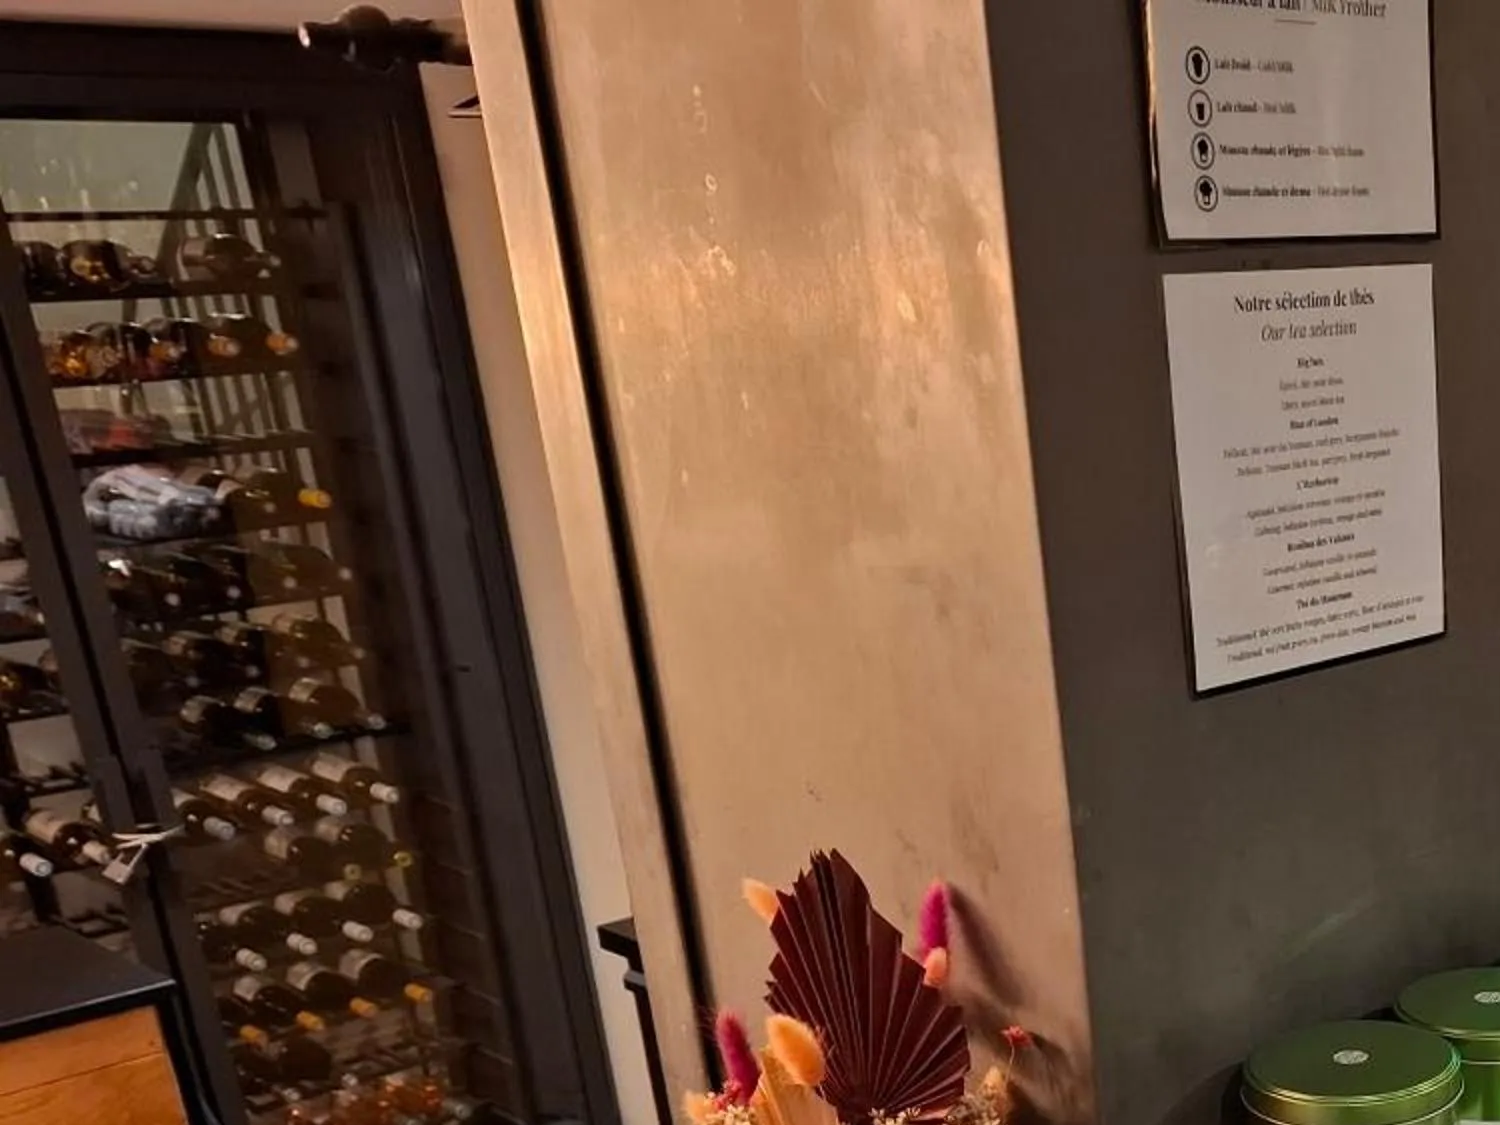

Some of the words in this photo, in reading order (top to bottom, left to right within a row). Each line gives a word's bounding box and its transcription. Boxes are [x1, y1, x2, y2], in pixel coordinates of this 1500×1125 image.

[1234, 293, 1272, 312] Notre
[1276, 289, 1331, 310] sélection
[1333, 289, 1349, 307] de
[1351, 287, 1375, 306] thés
[1261, 323, 1285, 342] Our
[1308, 319, 1358, 338] selection
